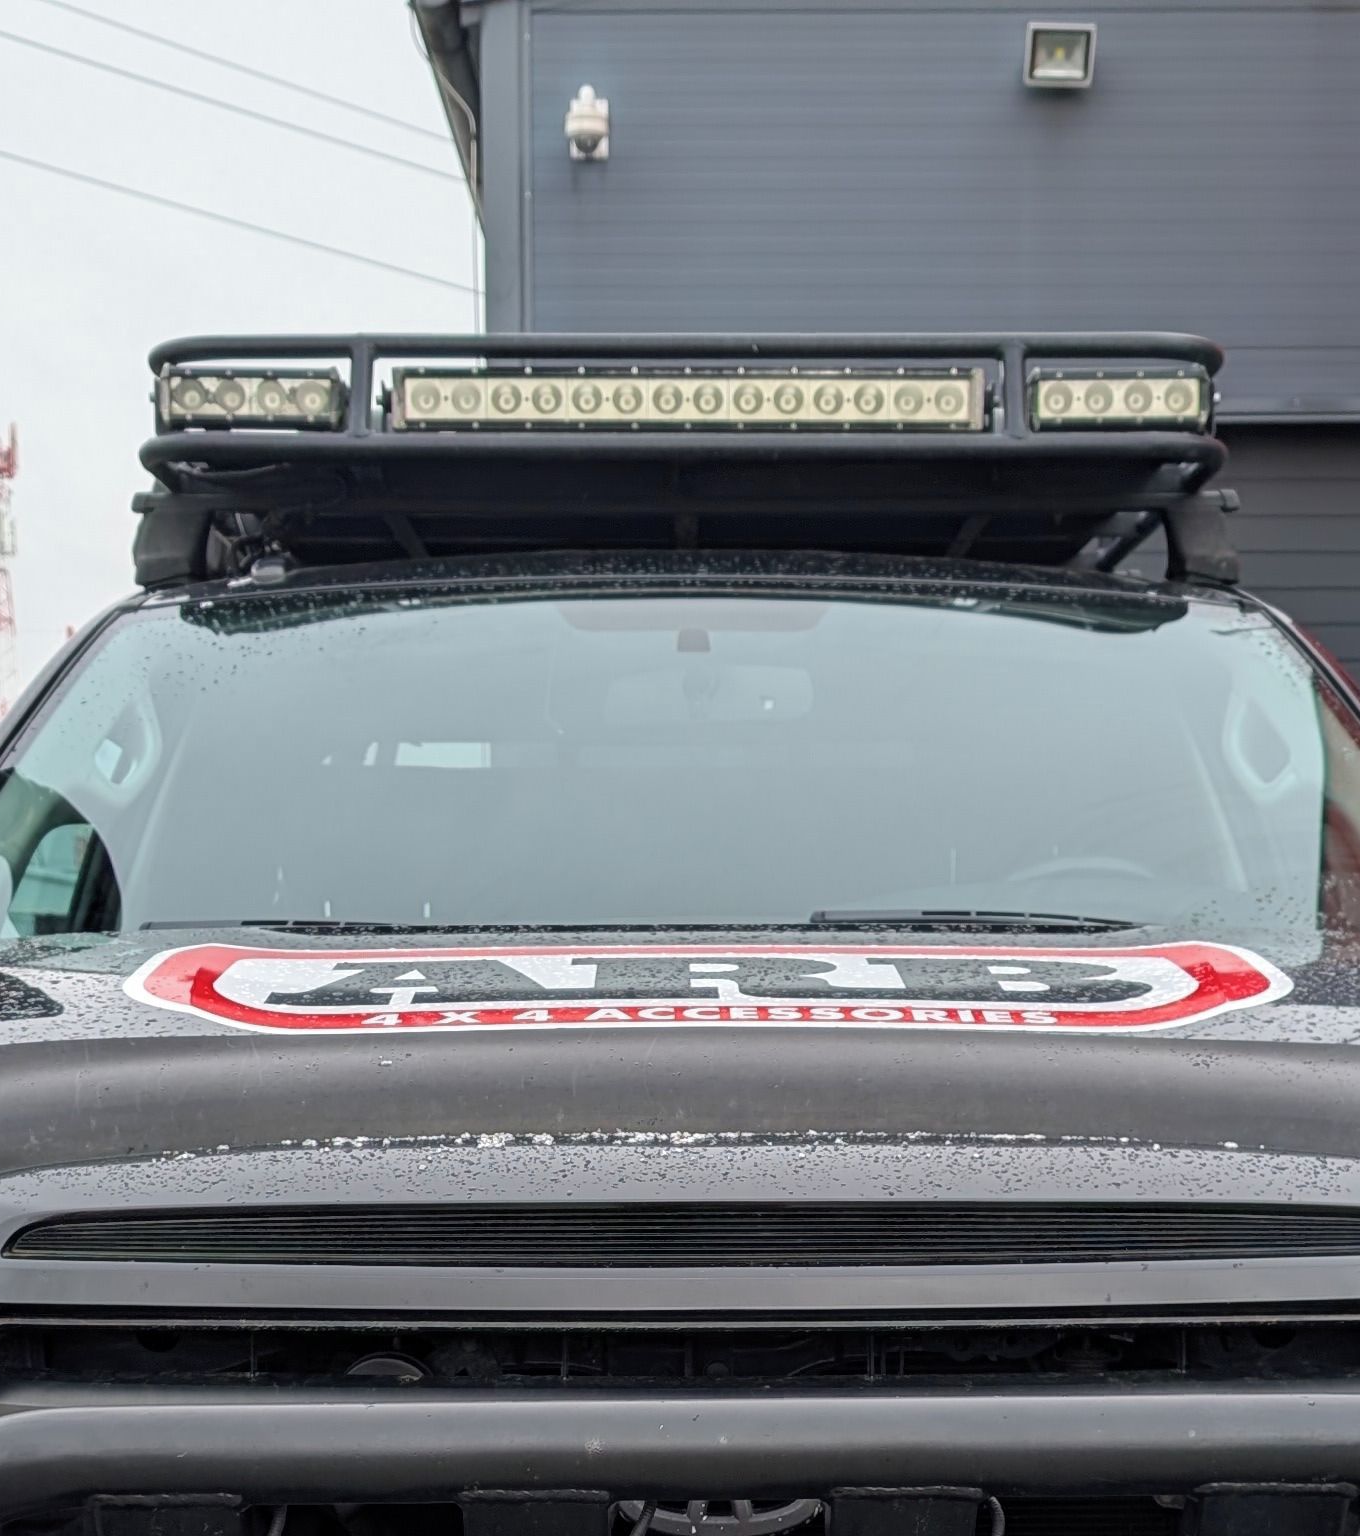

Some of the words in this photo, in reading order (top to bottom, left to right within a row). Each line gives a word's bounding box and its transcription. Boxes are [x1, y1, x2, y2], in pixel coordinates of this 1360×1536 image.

[263, 957, 1154, 1006] ARB
[360, 1012, 403, 1026] 4
[512, 1008, 553, 1022] 4
[583, 1007, 1057, 1025] ACCESSORIES
